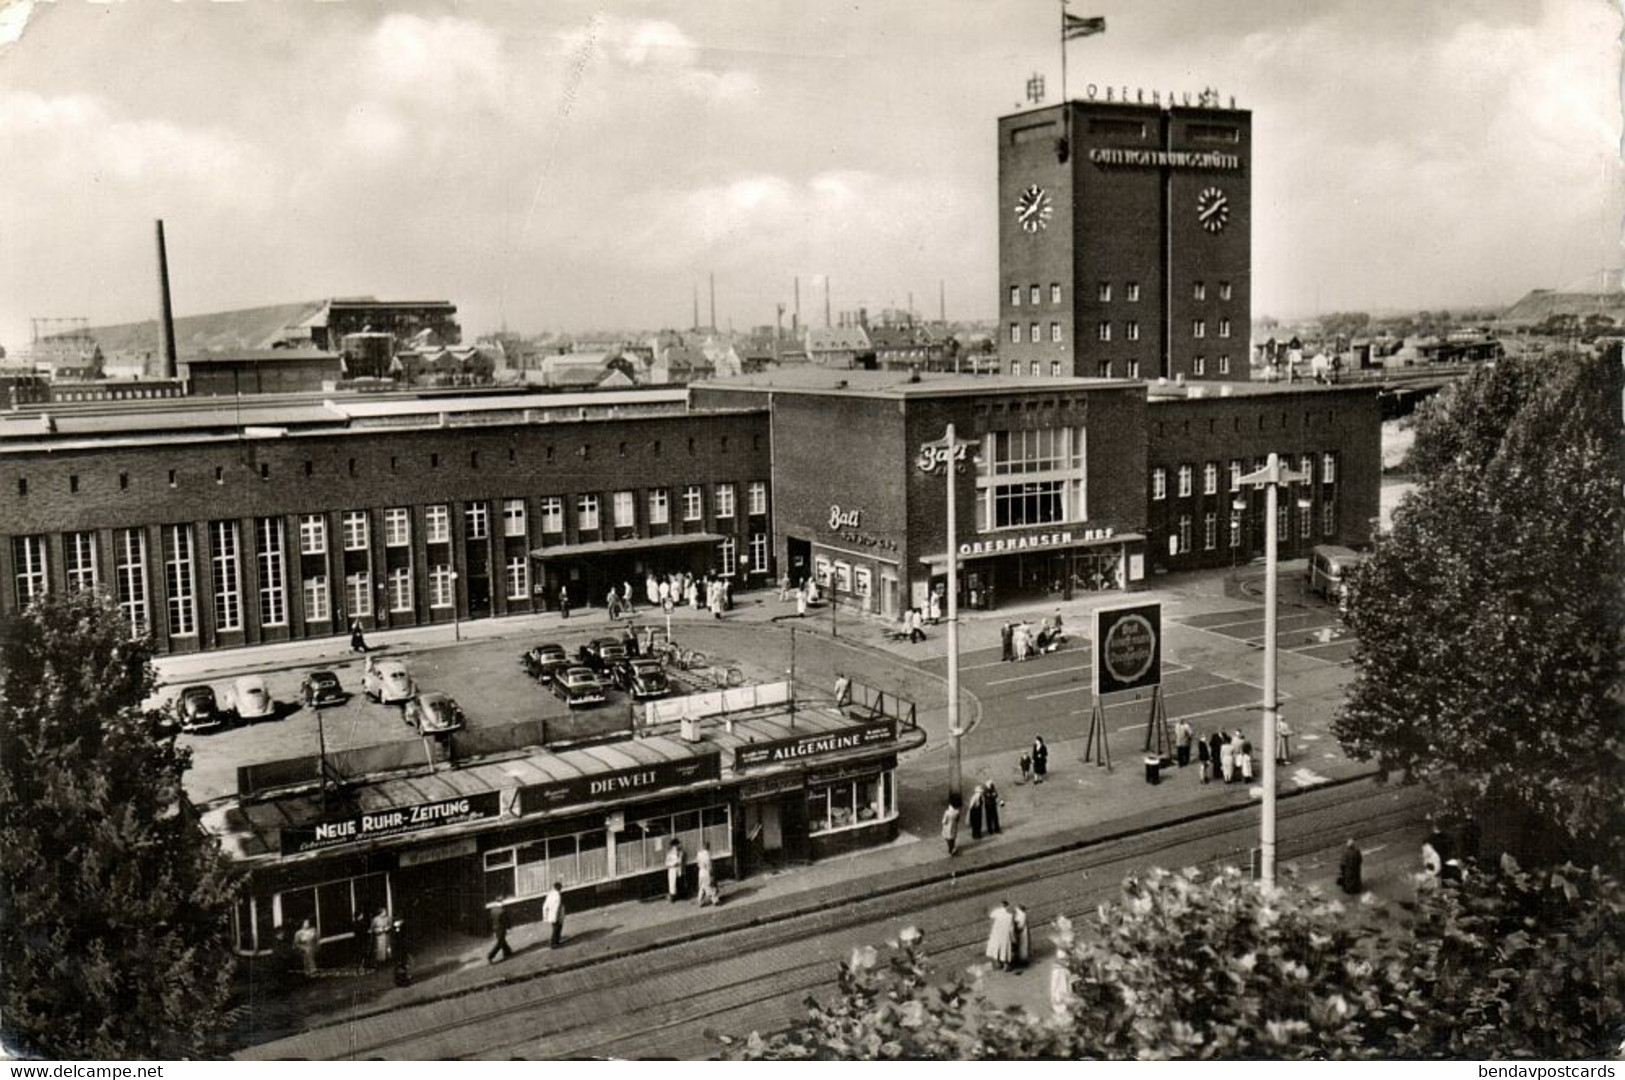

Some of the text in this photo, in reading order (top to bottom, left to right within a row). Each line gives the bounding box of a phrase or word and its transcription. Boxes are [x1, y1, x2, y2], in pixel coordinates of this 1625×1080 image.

[959, 527, 1115, 556] OBERHAUSEN HBF
[773, 733, 861, 760] ALLGEMEINE
[590, 778, 617, 794] DIE
[618, 770, 657, 788] WELT
[315, 799, 471, 841] NEUE RUHR-ZEITUNG
